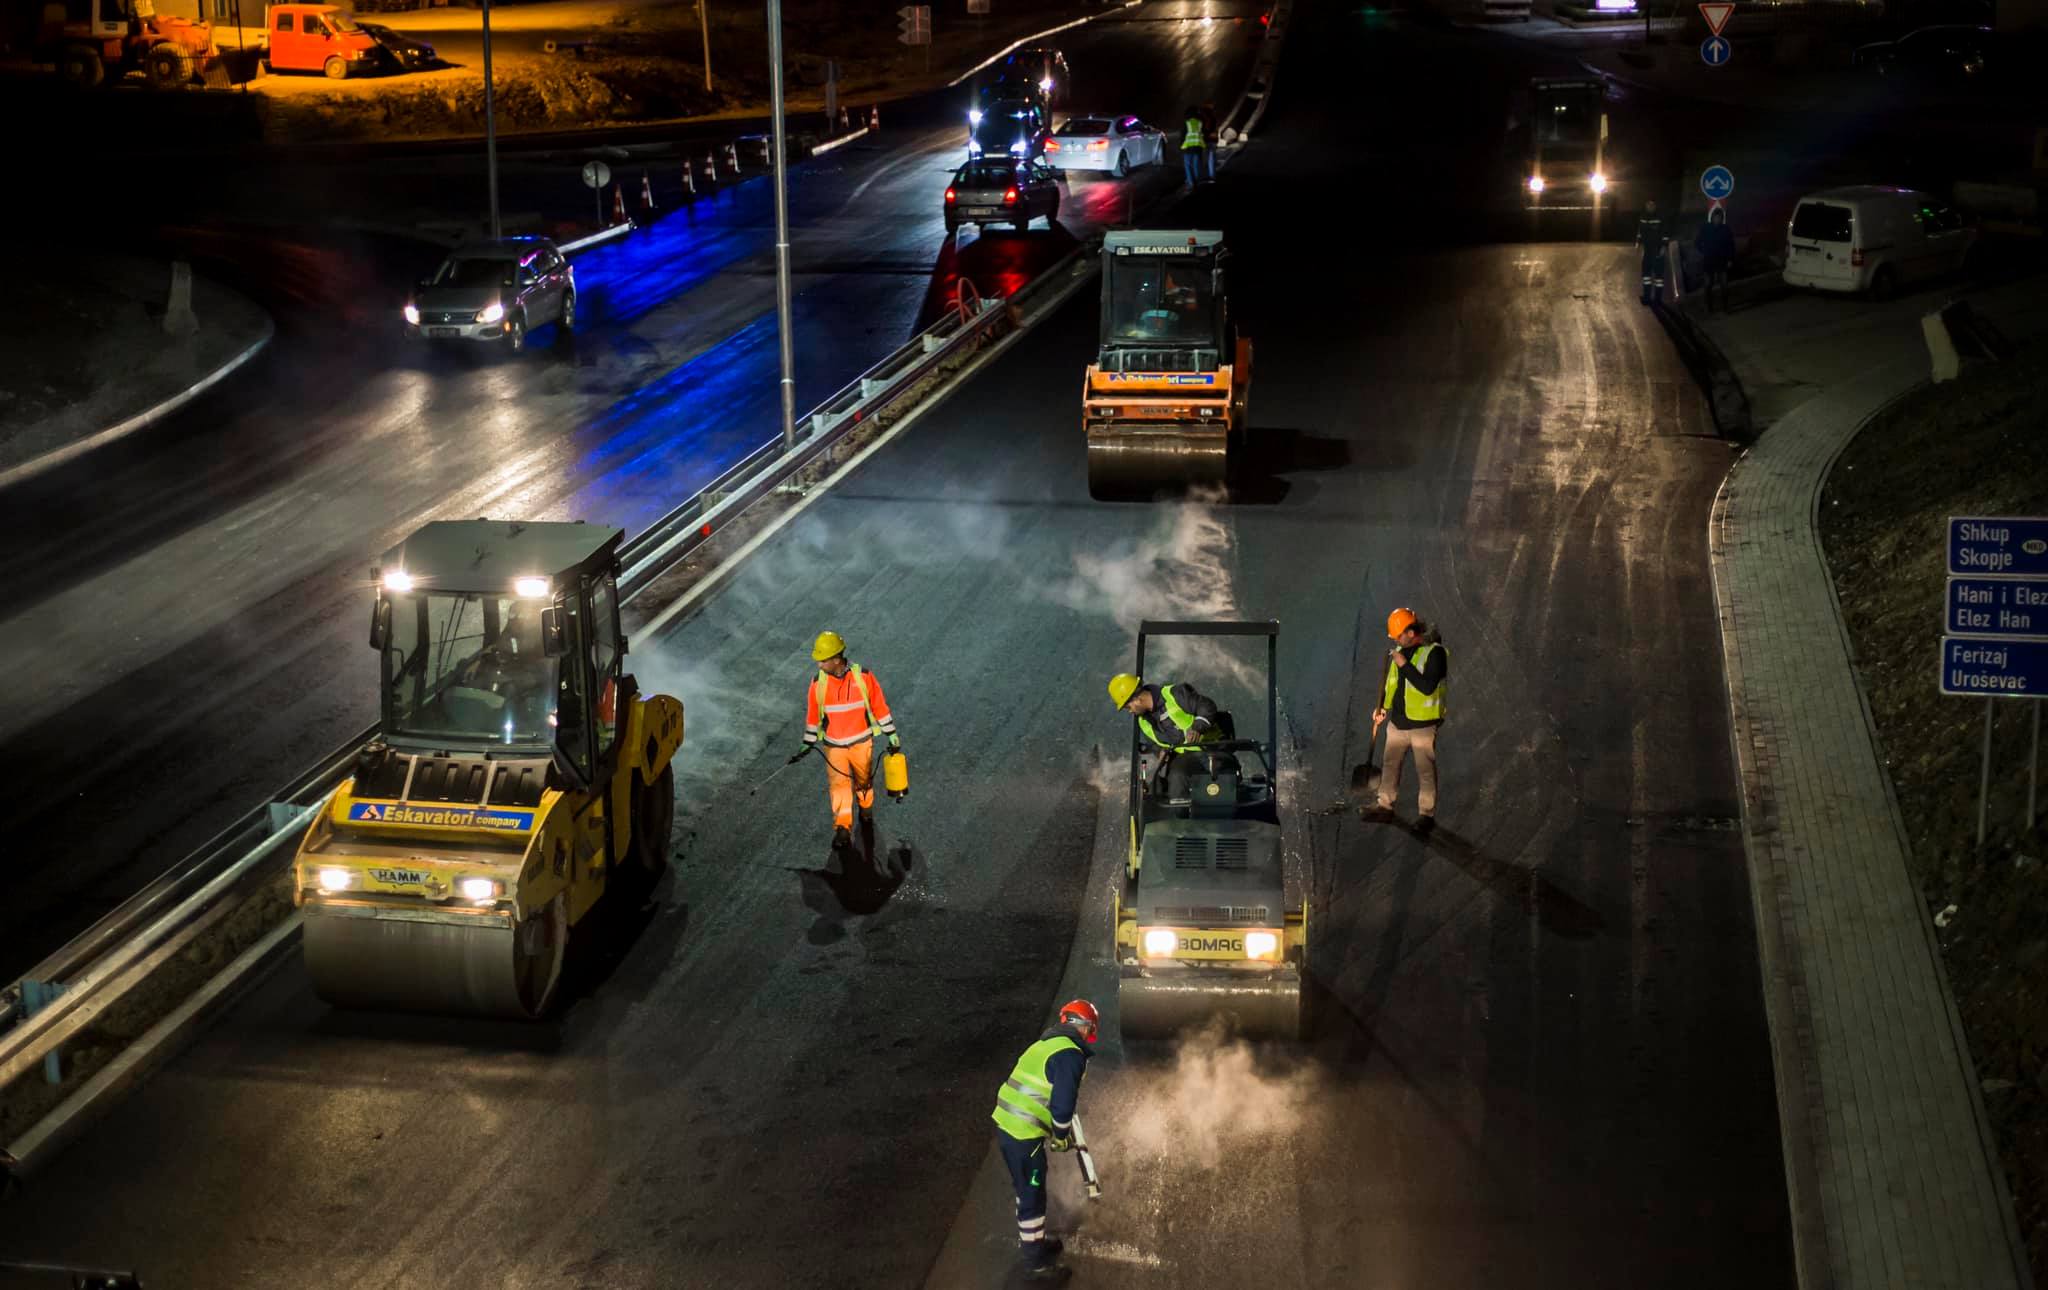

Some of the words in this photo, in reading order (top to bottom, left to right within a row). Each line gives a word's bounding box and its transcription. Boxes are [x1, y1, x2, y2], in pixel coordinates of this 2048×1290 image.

[1960, 523, 2009, 546] Shkup
[1959, 548, 2013, 570] Skopje
[1958, 586, 1993, 604] Hani
[2001, 587, 2007, 604] i
[2015, 587, 2048, 606] Elez
[1957, 608, 1991, 628] Elez
[2000, 610, 2030, 628] Han
[1953, 645, 2008, 670] Ferizaj
[1952, 669, 2027, 689] Uroševac
[383, 806, 474, 825] Eskavatori
[476, 817, 522, 828] company
[378, 870, 421, 882] HAMM
